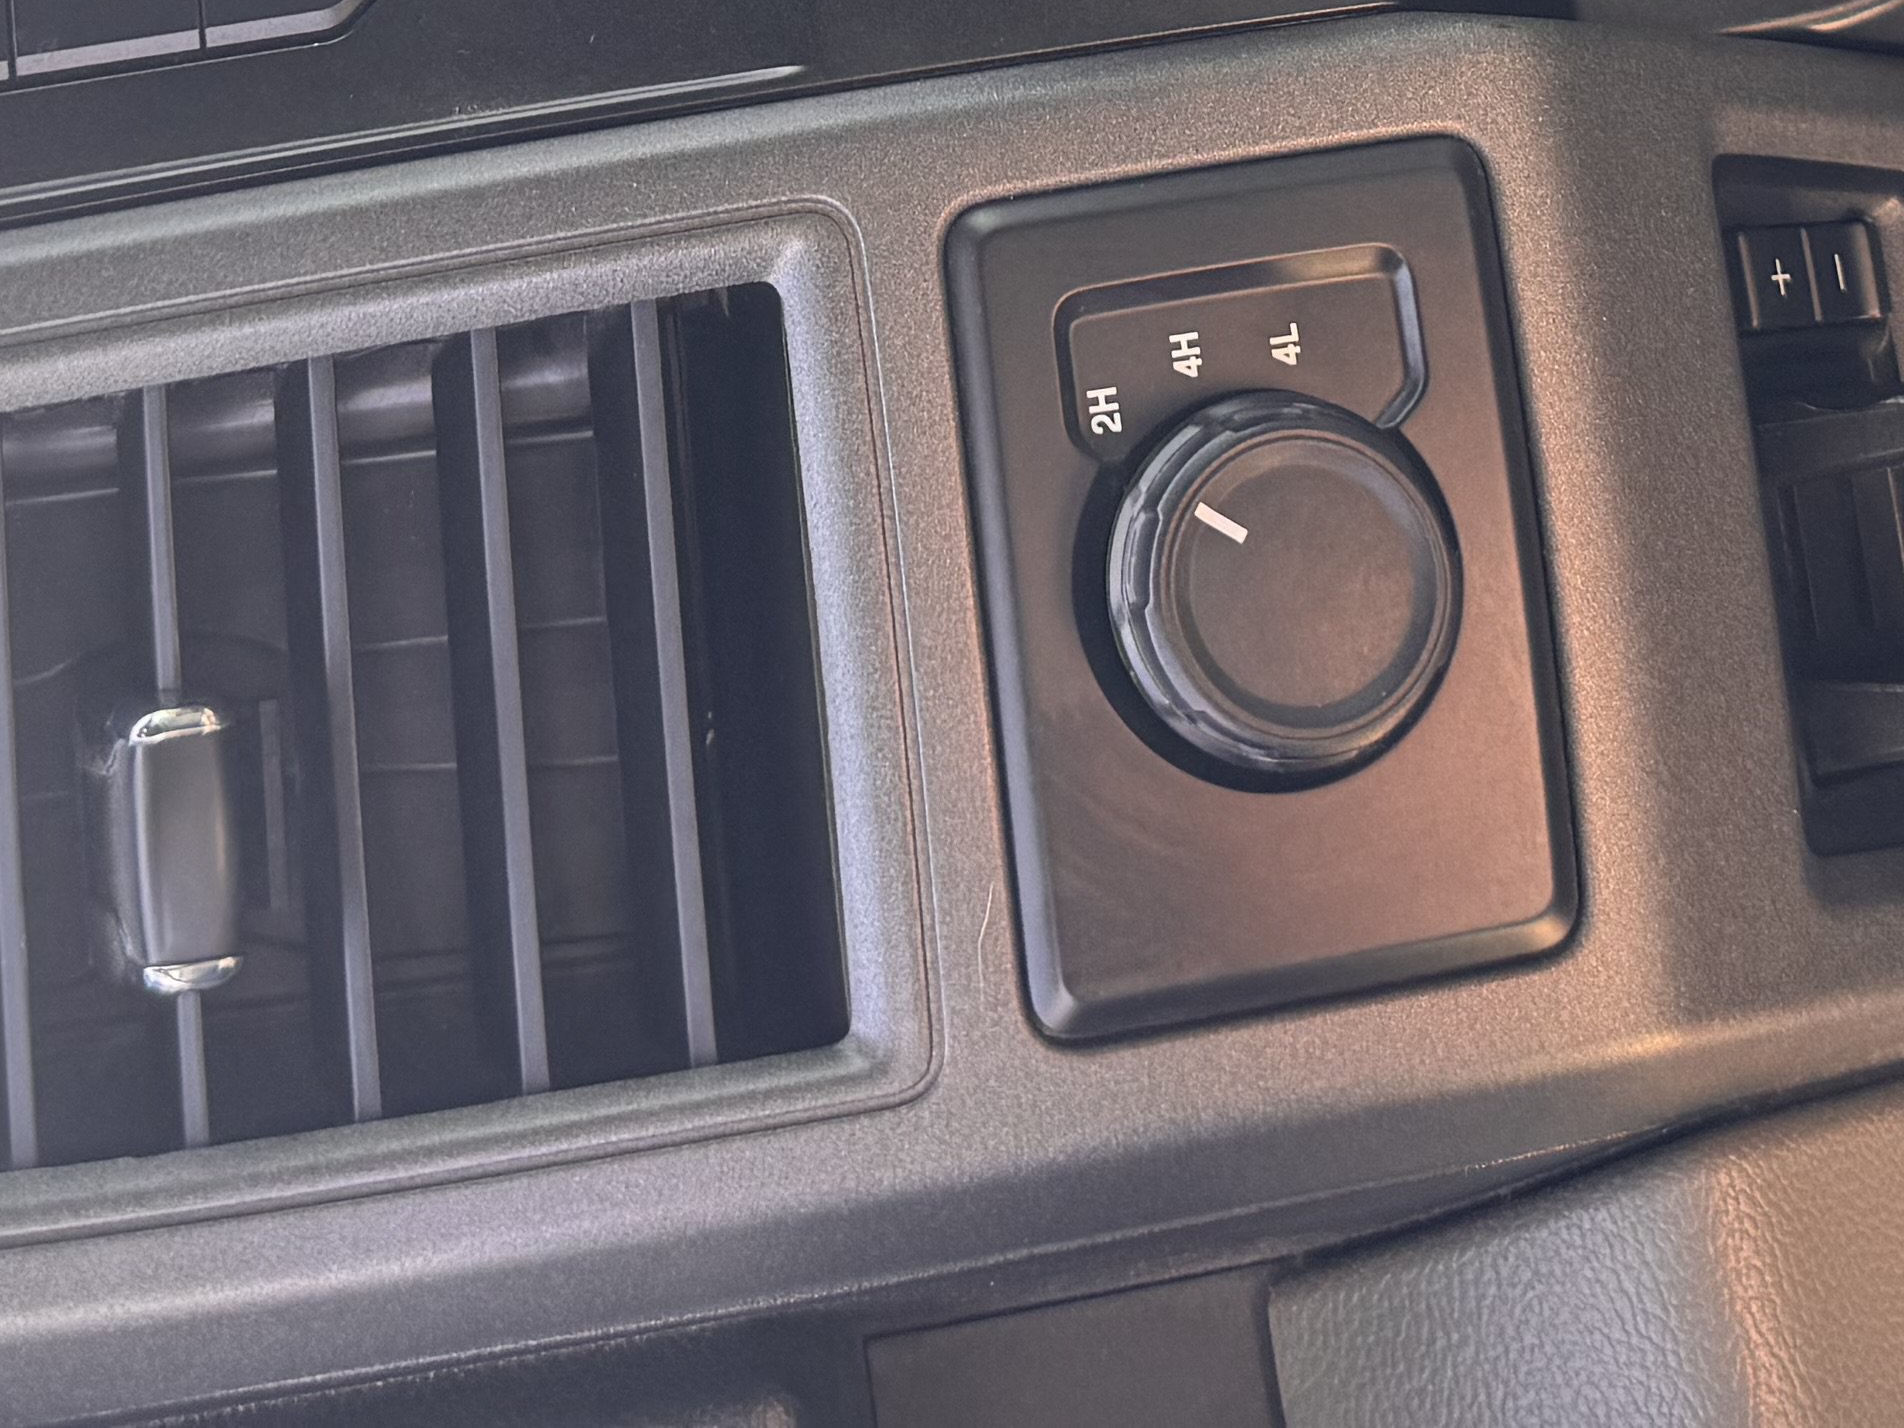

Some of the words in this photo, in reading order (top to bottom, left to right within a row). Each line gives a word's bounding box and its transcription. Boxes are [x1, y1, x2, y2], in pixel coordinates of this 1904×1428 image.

[1168, 331, 1203, 378] 4H
[1269, 322, 1301, 366] 4L
[1086, 386, 1123, 435] 2H
